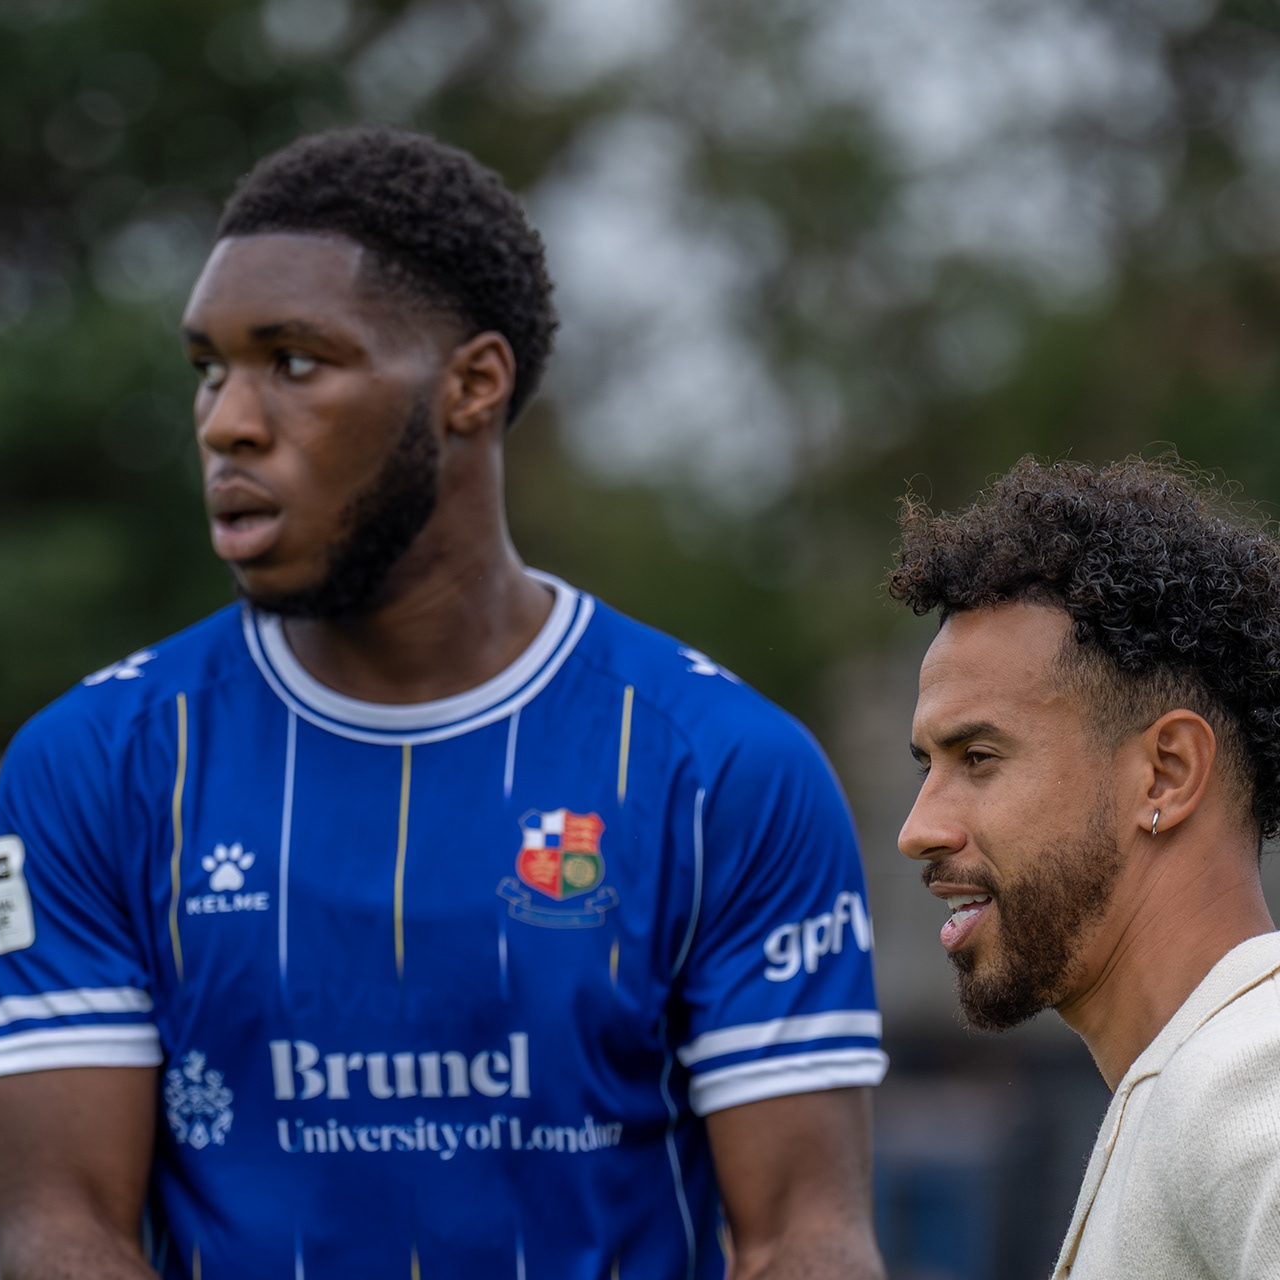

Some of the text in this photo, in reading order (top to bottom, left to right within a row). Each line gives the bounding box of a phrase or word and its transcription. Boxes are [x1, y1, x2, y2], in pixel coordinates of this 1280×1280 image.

[186, 892, 270, 914] KELME
[269, 1032, 531, 1100] Brunel
[277, 1113, 623, 1160] University of London
